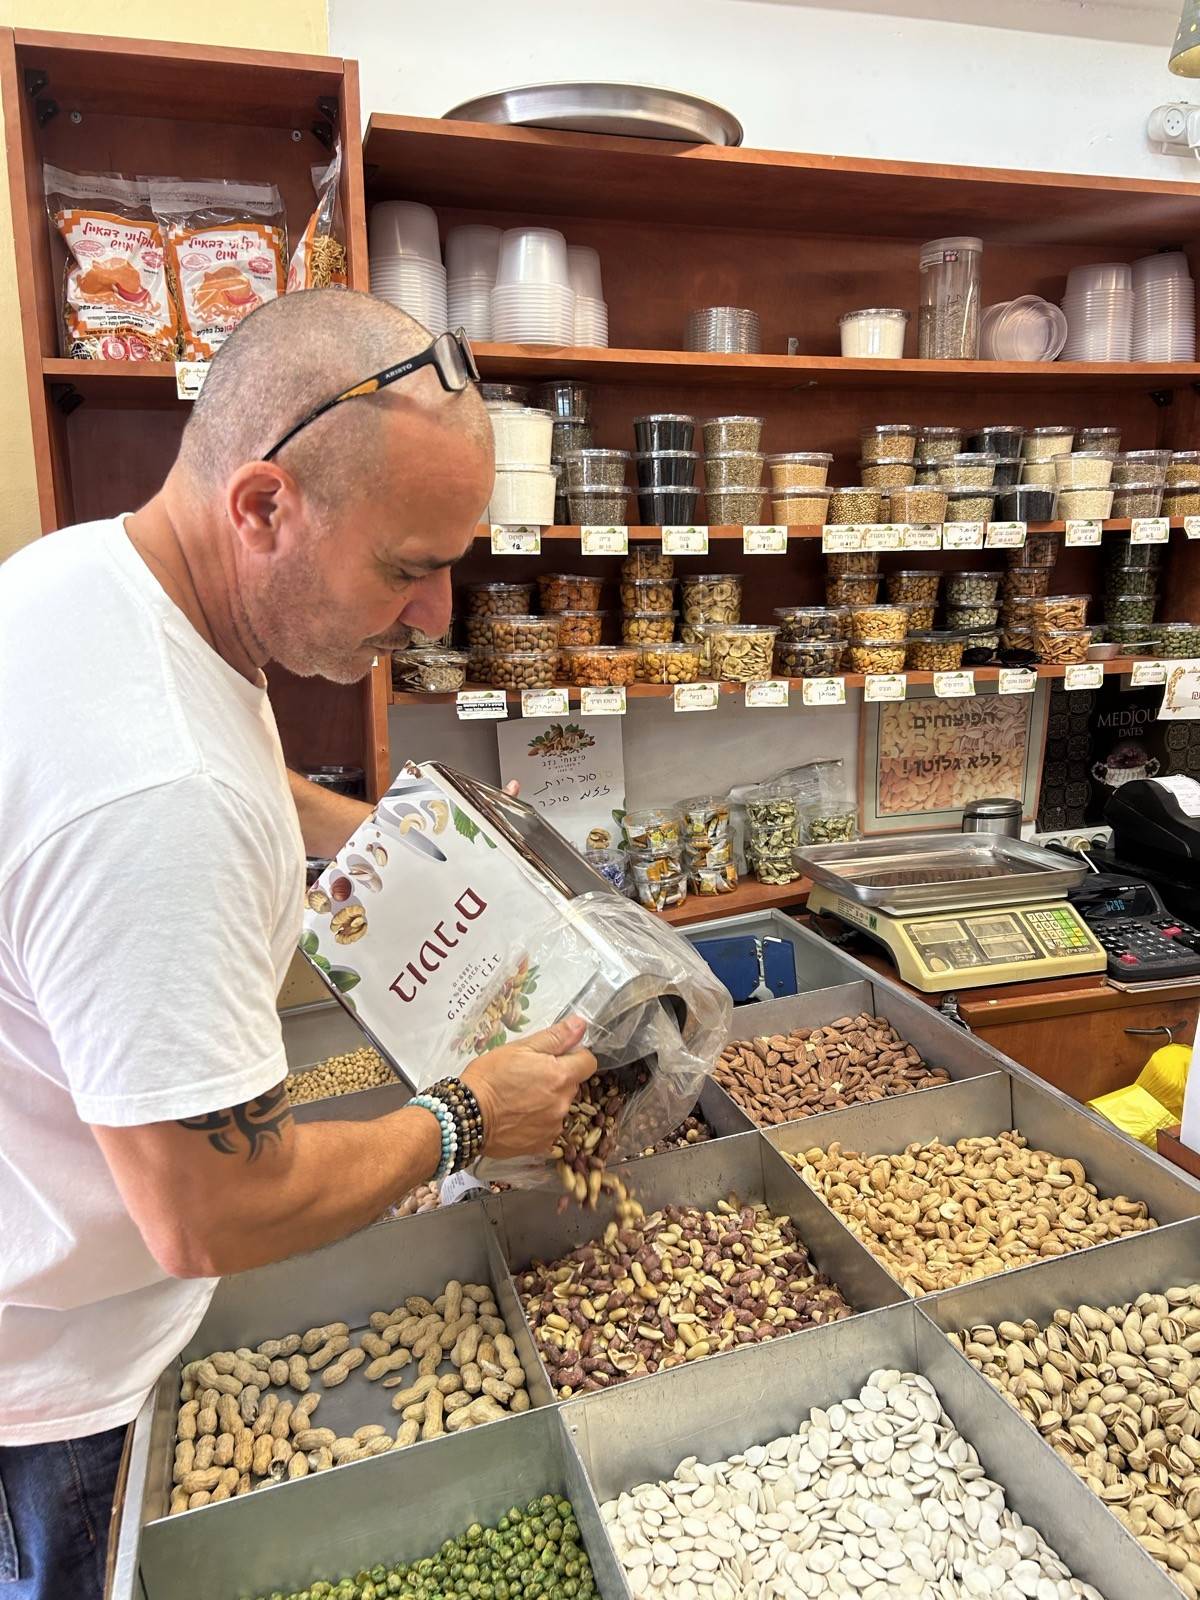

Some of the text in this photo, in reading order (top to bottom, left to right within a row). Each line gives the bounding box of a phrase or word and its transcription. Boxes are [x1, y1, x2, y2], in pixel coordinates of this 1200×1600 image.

[385, 363, 413, 380] ARISTO
[912, 711, 996, 730] הפיצוחים
[1097, 708, 1158, 728] MEDJOU
[1118, 727, 1144, 738] DATES
[967, 752, 1002, 770] ללא
[539, 795, 570, 808] סוכר
[389, 887, 488, 1003] בוטנים
[447, 985, 480, 1020] פיצוחי
